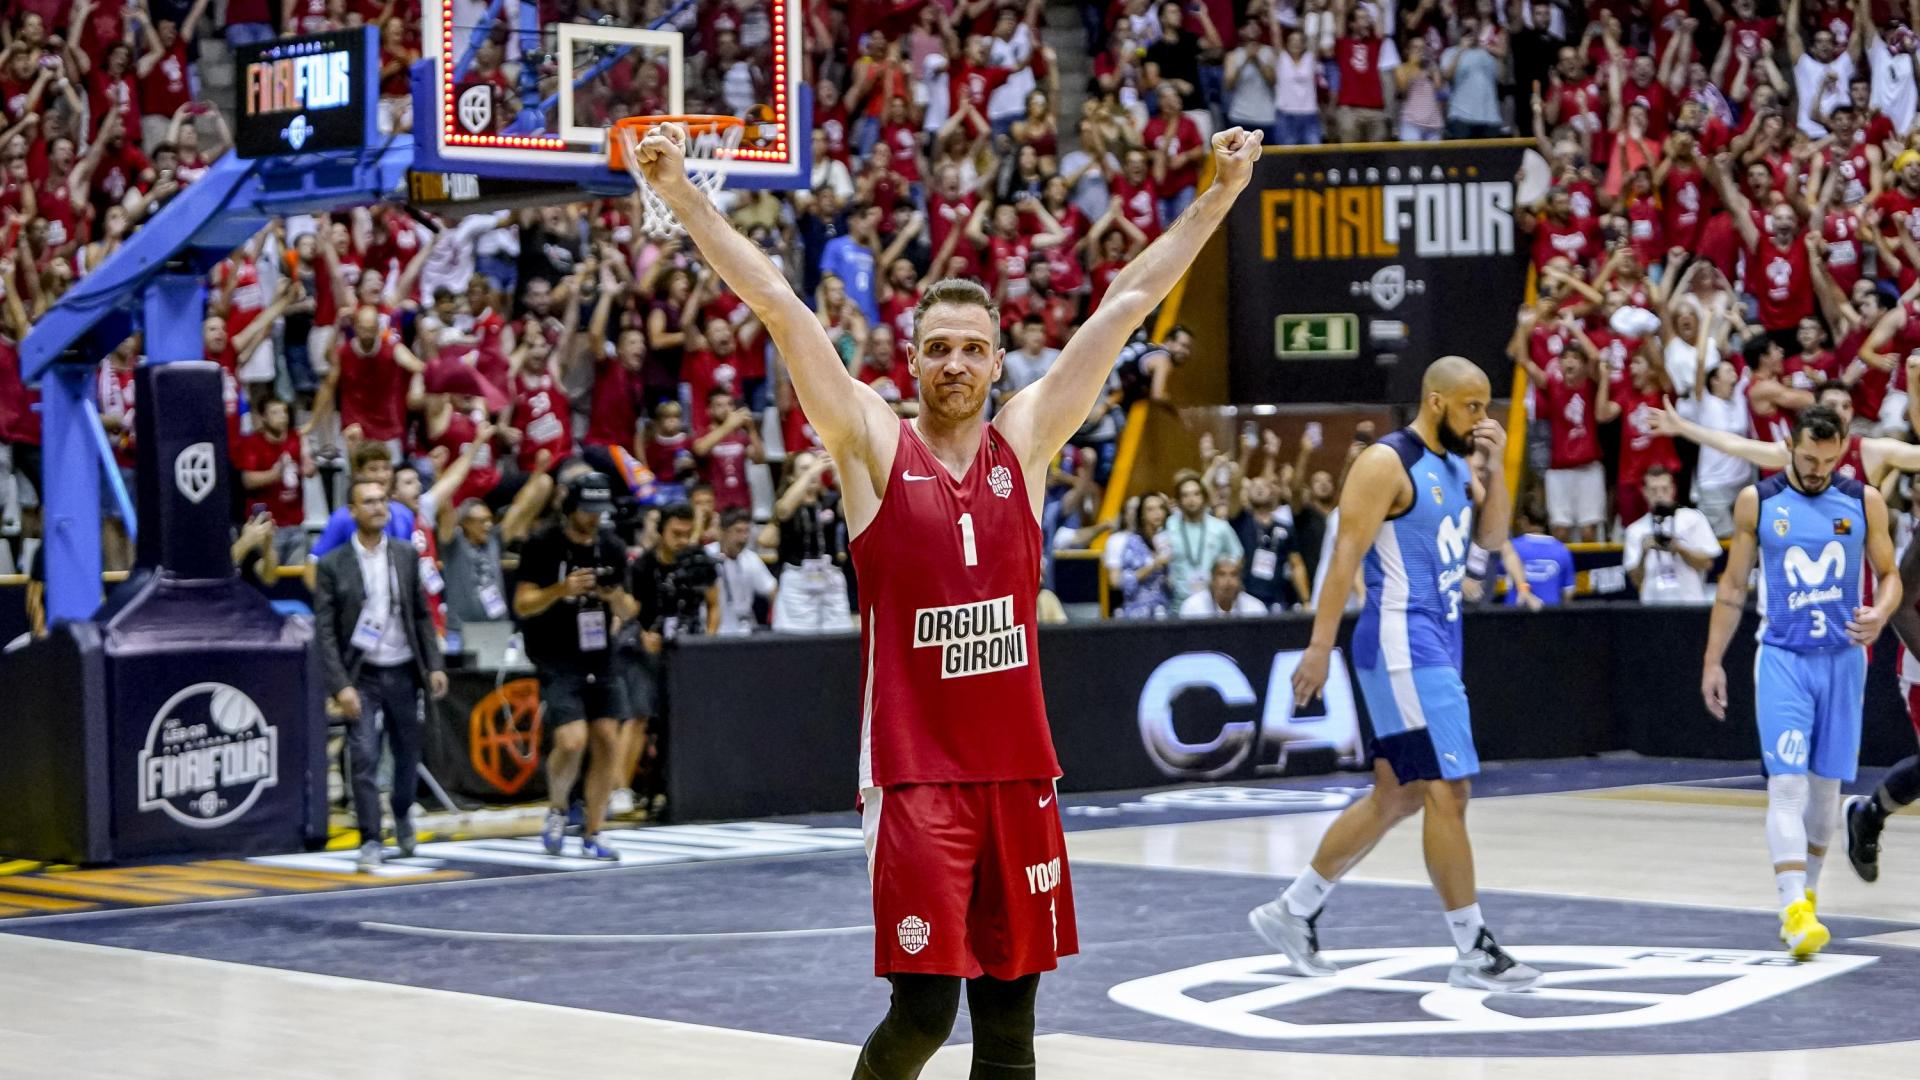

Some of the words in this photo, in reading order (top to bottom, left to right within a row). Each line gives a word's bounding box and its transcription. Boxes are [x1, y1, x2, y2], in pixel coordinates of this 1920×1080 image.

[957, 513, 978, 566] 1
[917, 601, 1012, 643] ORGULL
[1809, 609, 1827, 638] 3
[945, 627, 1023, 674] GIRONÍ
